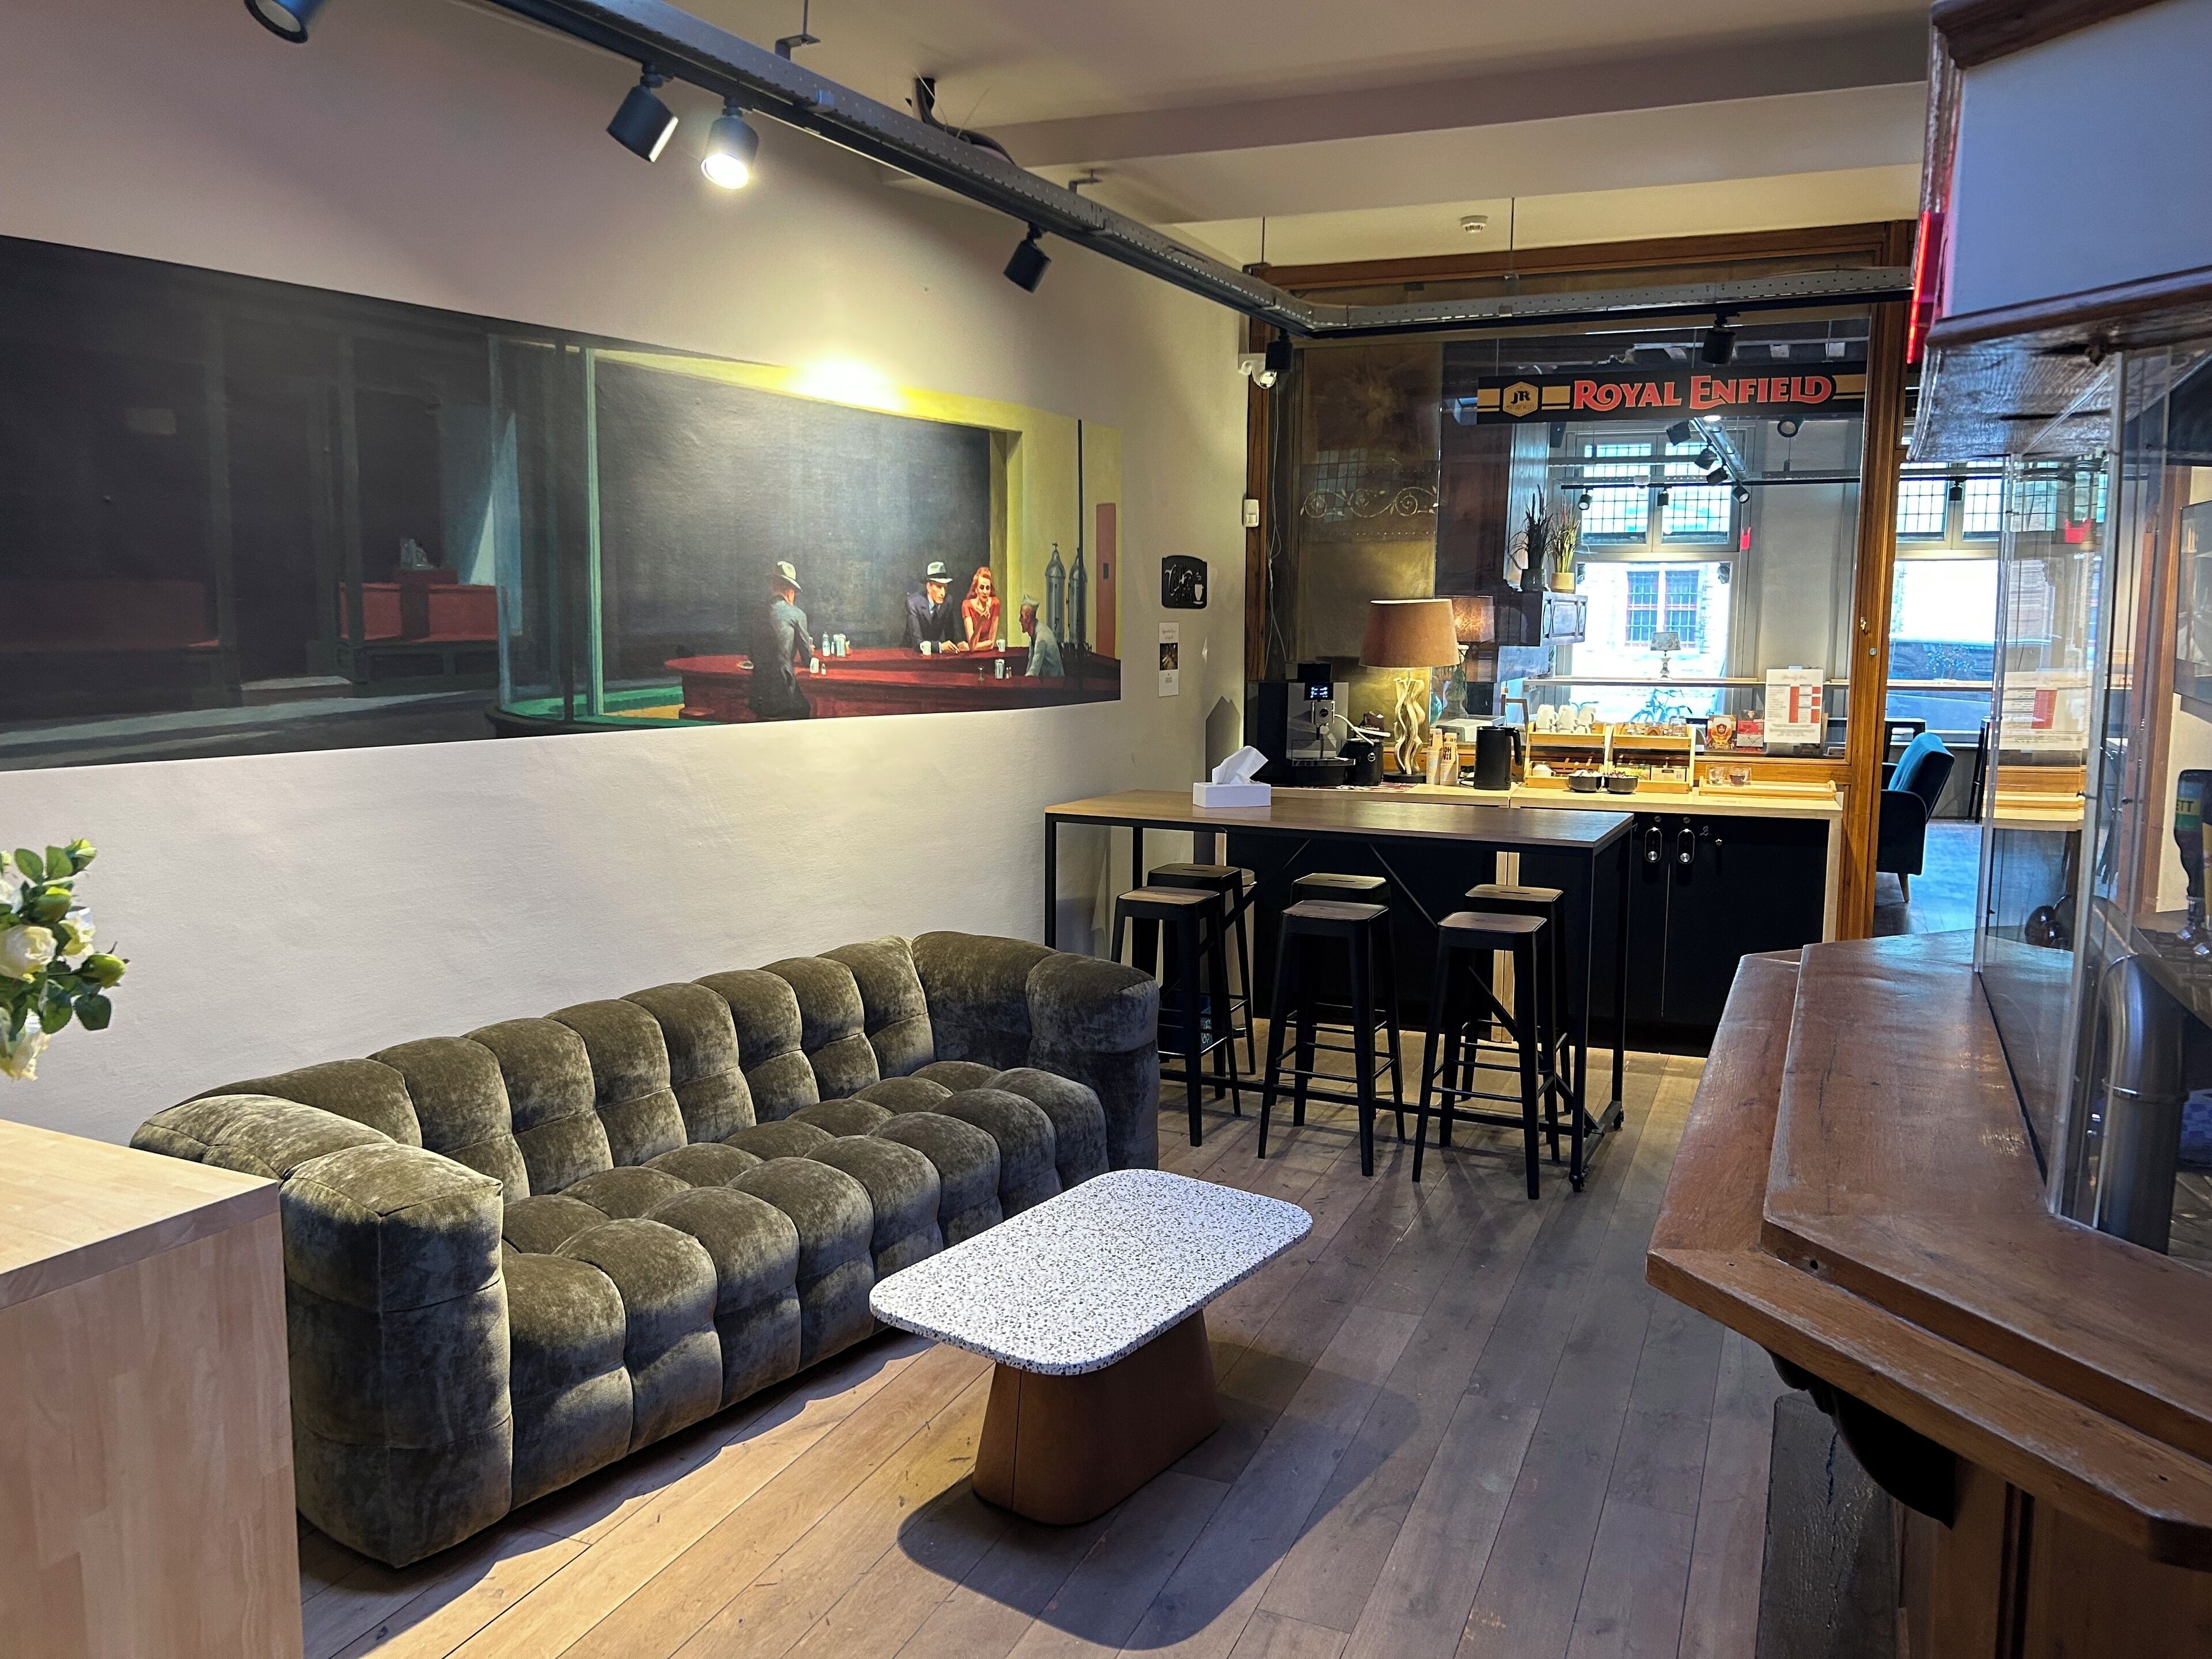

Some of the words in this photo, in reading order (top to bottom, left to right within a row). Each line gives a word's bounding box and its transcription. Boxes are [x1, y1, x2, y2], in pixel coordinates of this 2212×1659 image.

[1510, 391, 1531, 404] JR
[1573, 380, 1682, 412] ROYAL
[1690, 375, 1832, 410] ENFIELD
